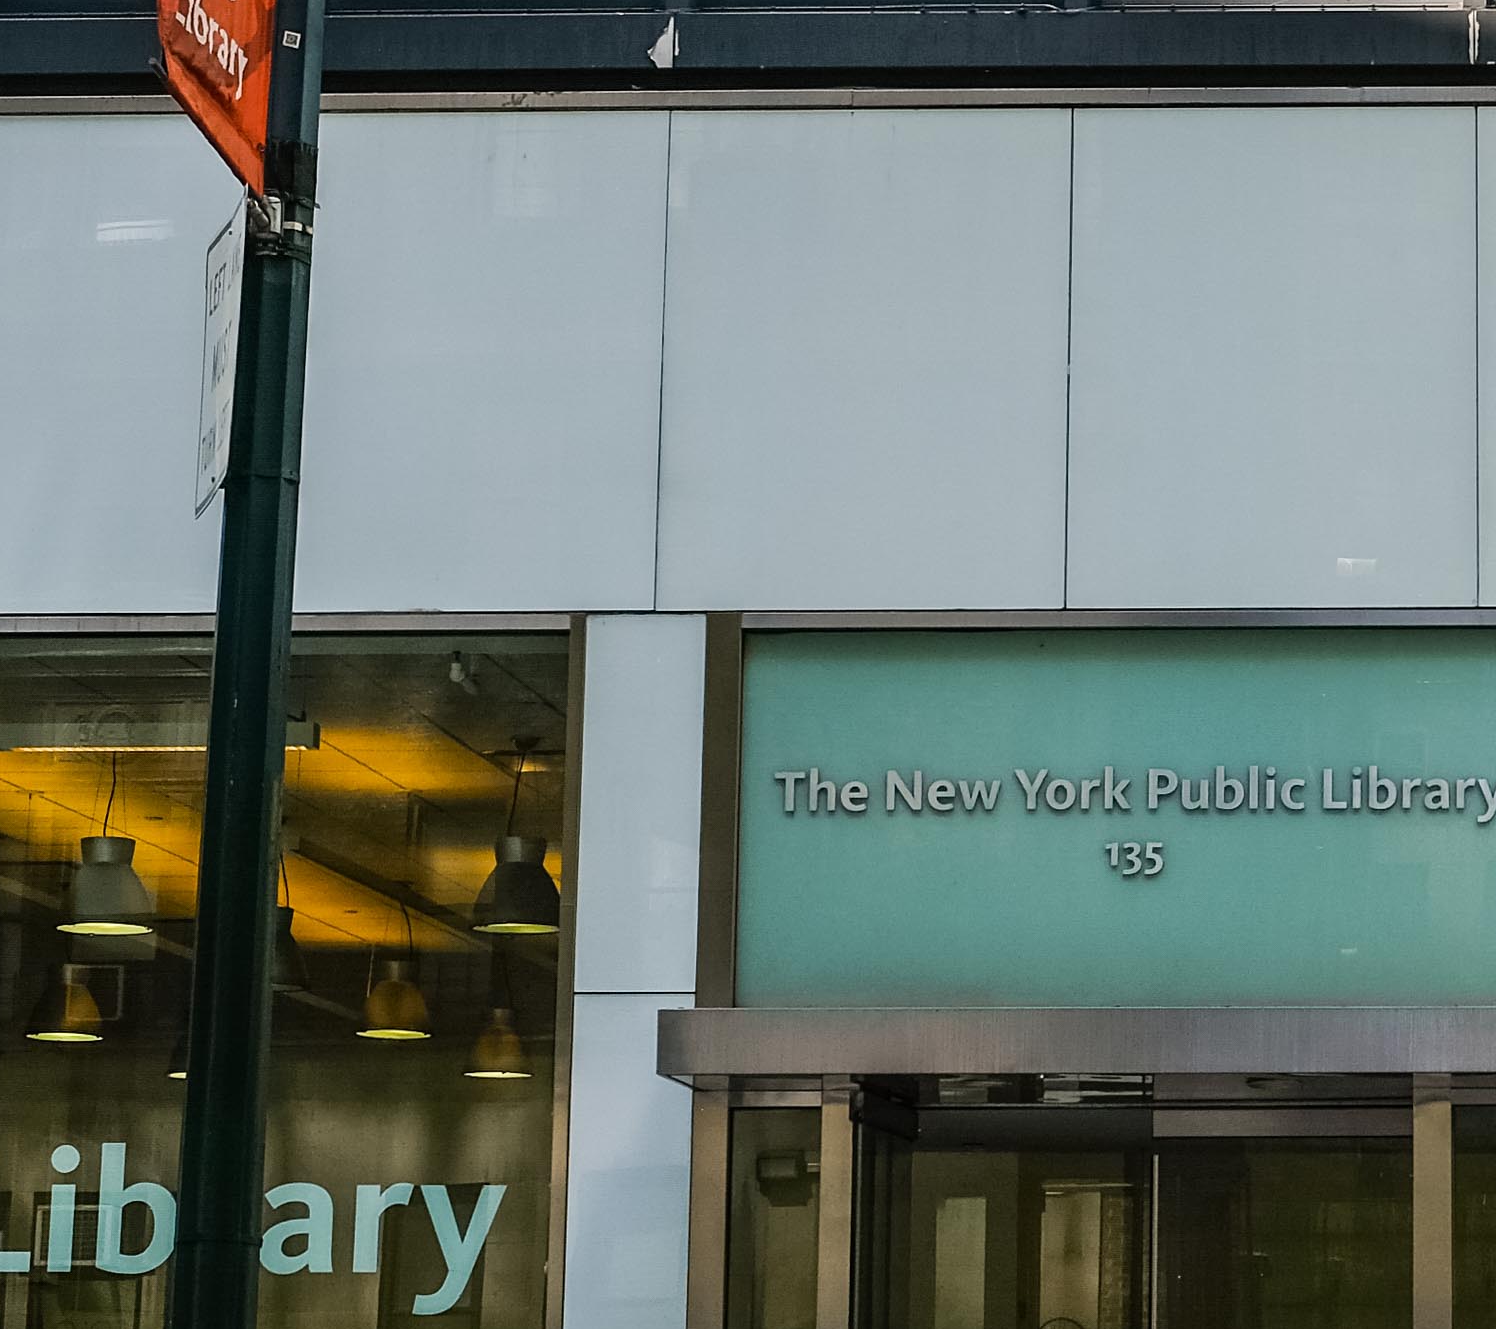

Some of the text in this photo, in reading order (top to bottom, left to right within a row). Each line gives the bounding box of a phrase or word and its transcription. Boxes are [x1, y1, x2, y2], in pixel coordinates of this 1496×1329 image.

[774, 769, 869, 812] The
[884, 770, 1001, 812] New
[1014, 766, 1131, 812] York
[1146, 766, 1306, 812] Public
[1104, 841, 1164, 876] 135
